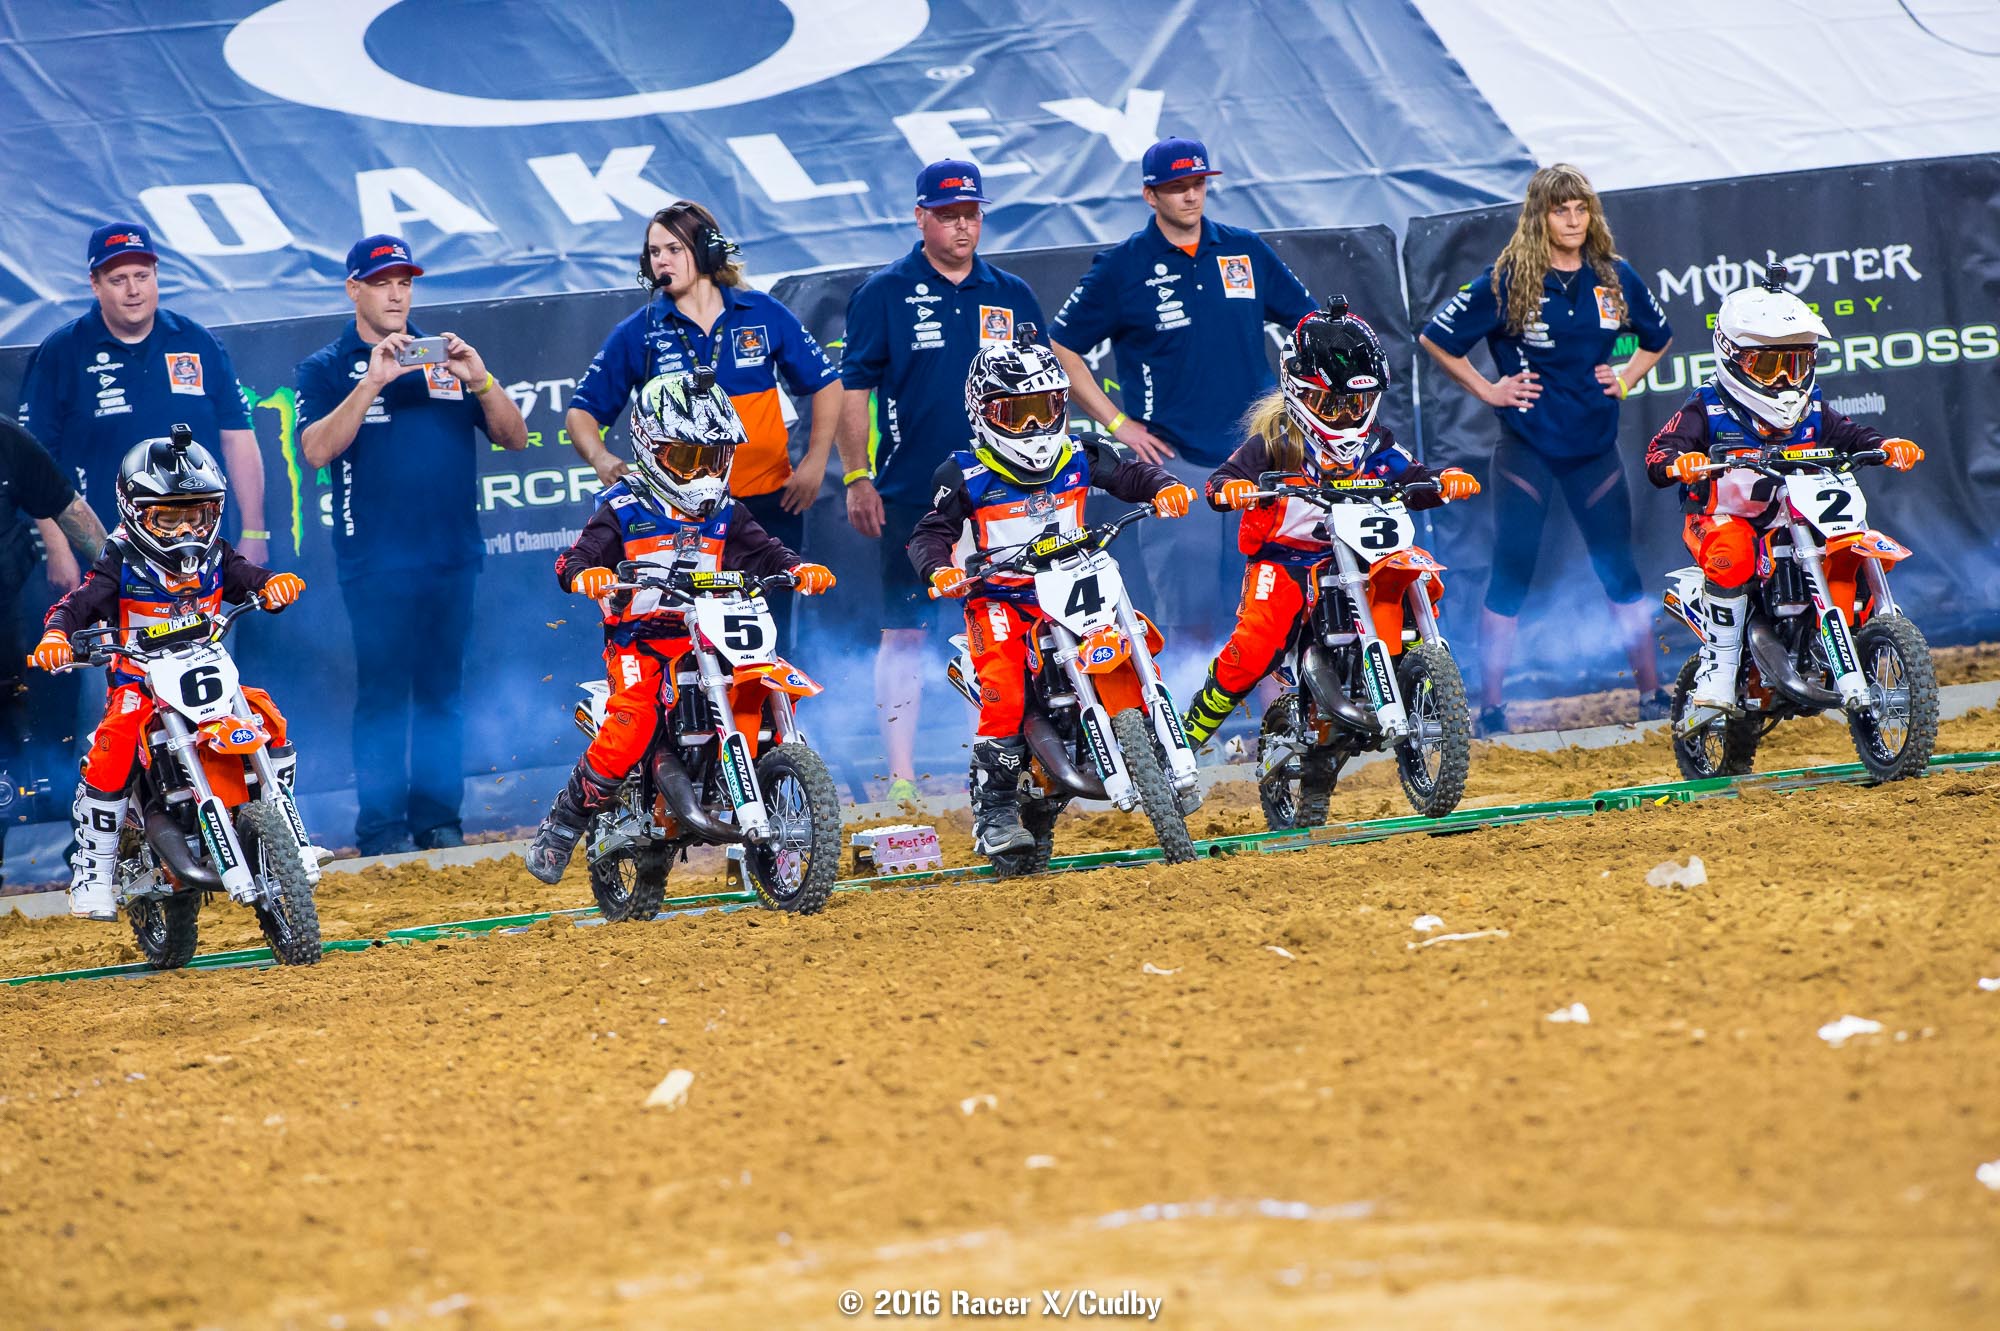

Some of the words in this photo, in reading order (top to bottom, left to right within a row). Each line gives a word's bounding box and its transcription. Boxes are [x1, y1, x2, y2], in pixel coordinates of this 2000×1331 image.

[138, 88, 1166, 256] OAKLEY
[1657, 243, 1922, 306] MONSTER
[1016, 369, 1061, 393] FOX
[703, 427, 733, 441] 6D
[180, 479, 207, 490] 6D
[342, 460, 355, 537] OAKLEY
[1816, 488, 1853, 524] 2
[1360, 516, 1400, 550] 3
[1064, 574, 1106, 618] 4
[1254, 563, 1276, 601] KTM
[149, 614, 198, 637] PROTAPER
[723, 615, 764, 651] 5
[986, 601, 1011, 642] KTM
[1083, 618, 1098, 627] KTM
[1710, 603, 1736, 627] G
[1830, 619, 1855, 673] DUNLOP
[179, 665, 223, 708] 6
[1371, 652, 1393, 702] DUNLOP
[200, 707, 216, 716] KTM
[1087, 719, 1114, 774] DUNLOP
[725, 762, 743, 806] MOTOREX
[731, 745, 755, 801] DUNLOP
[91, 807, 117, 833] G
[206, 811, 235, 866] DUNLOP
[887, 834, 938, 848] Emerson
